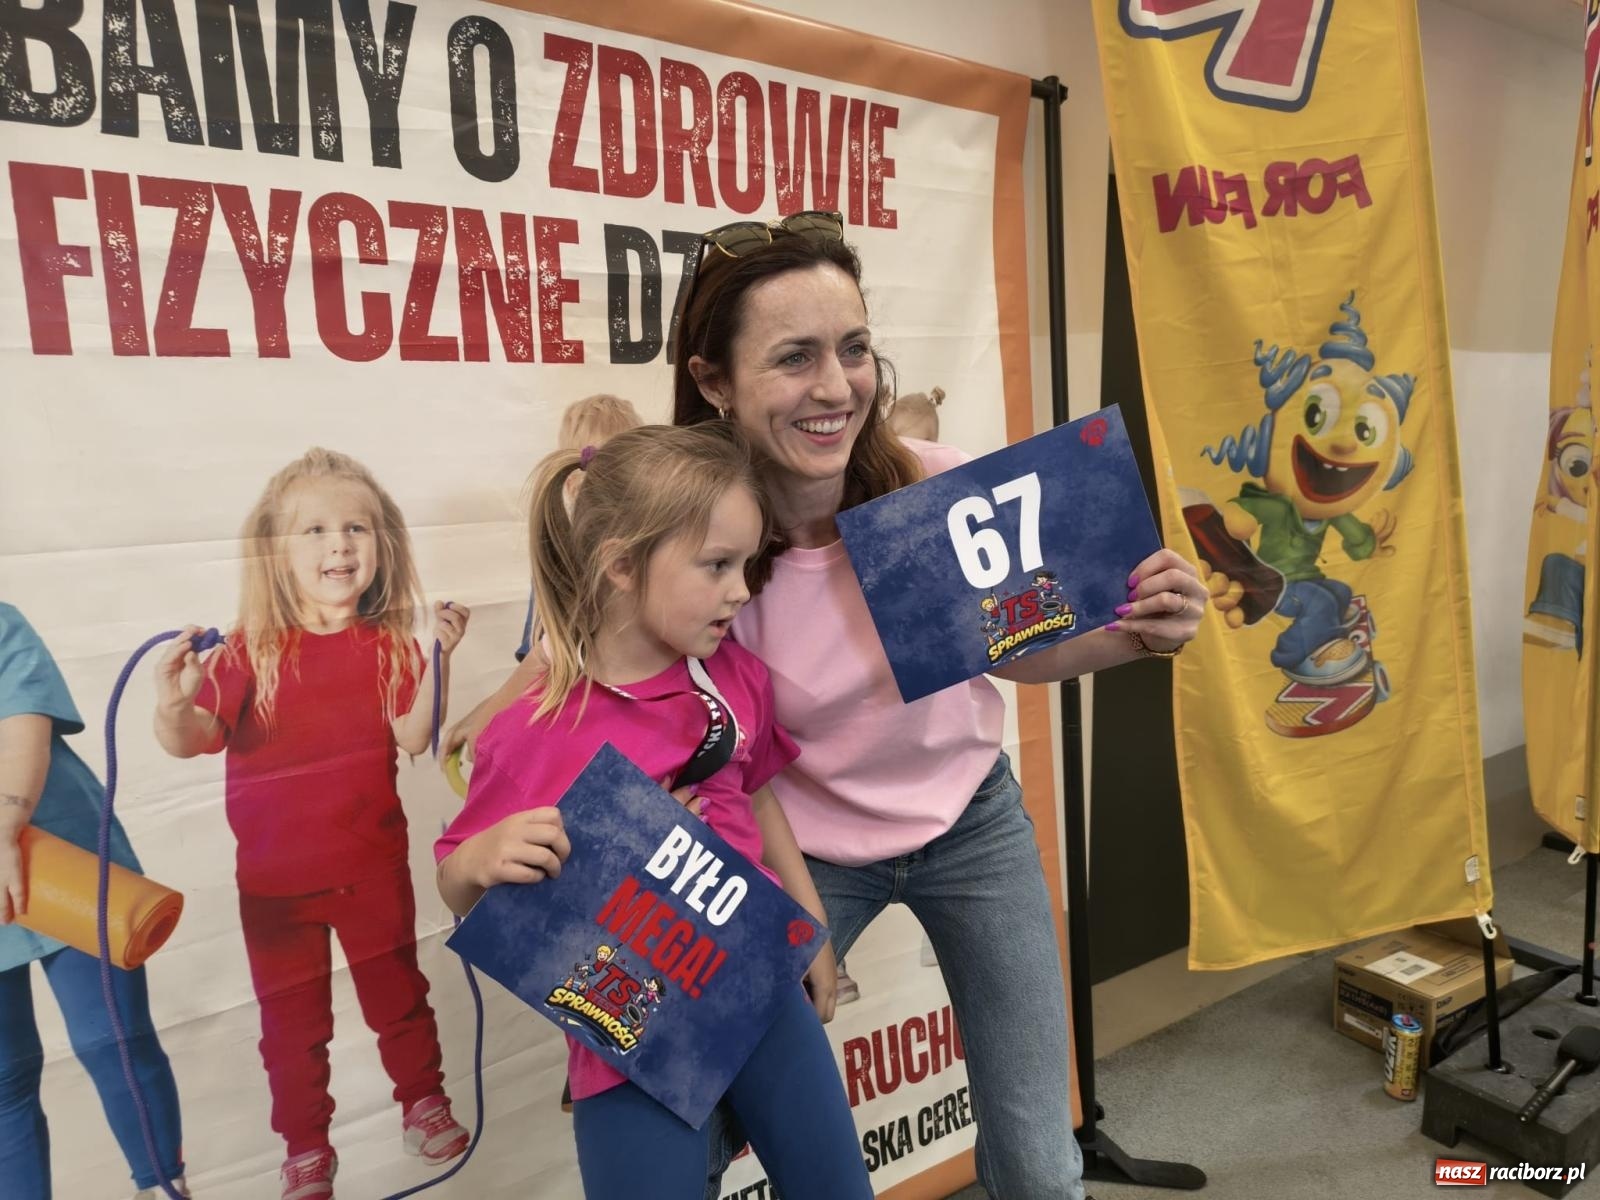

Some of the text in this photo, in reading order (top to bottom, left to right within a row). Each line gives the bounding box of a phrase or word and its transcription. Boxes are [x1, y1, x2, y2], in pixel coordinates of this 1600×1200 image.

[447, 14, 520, 183] O
[543, 32, 899, 229] ZDROWIE
[8, 160, 585, 364] FIZYCZNE
[947, 471, 1044, 590] 67
[988, 613, 1074, 662] SPRAWNOŚCI
[1001, 589, 1040, 626] TS
[644, 824, 749, 927] BYŁO
[595, 875, 728, 1000] MEGA!
[548, 987, 637, 1050] SPRAWNOŚCI
[594, 963, 642, 1006] TS
[861, 1114, 914, 1173] SKA
